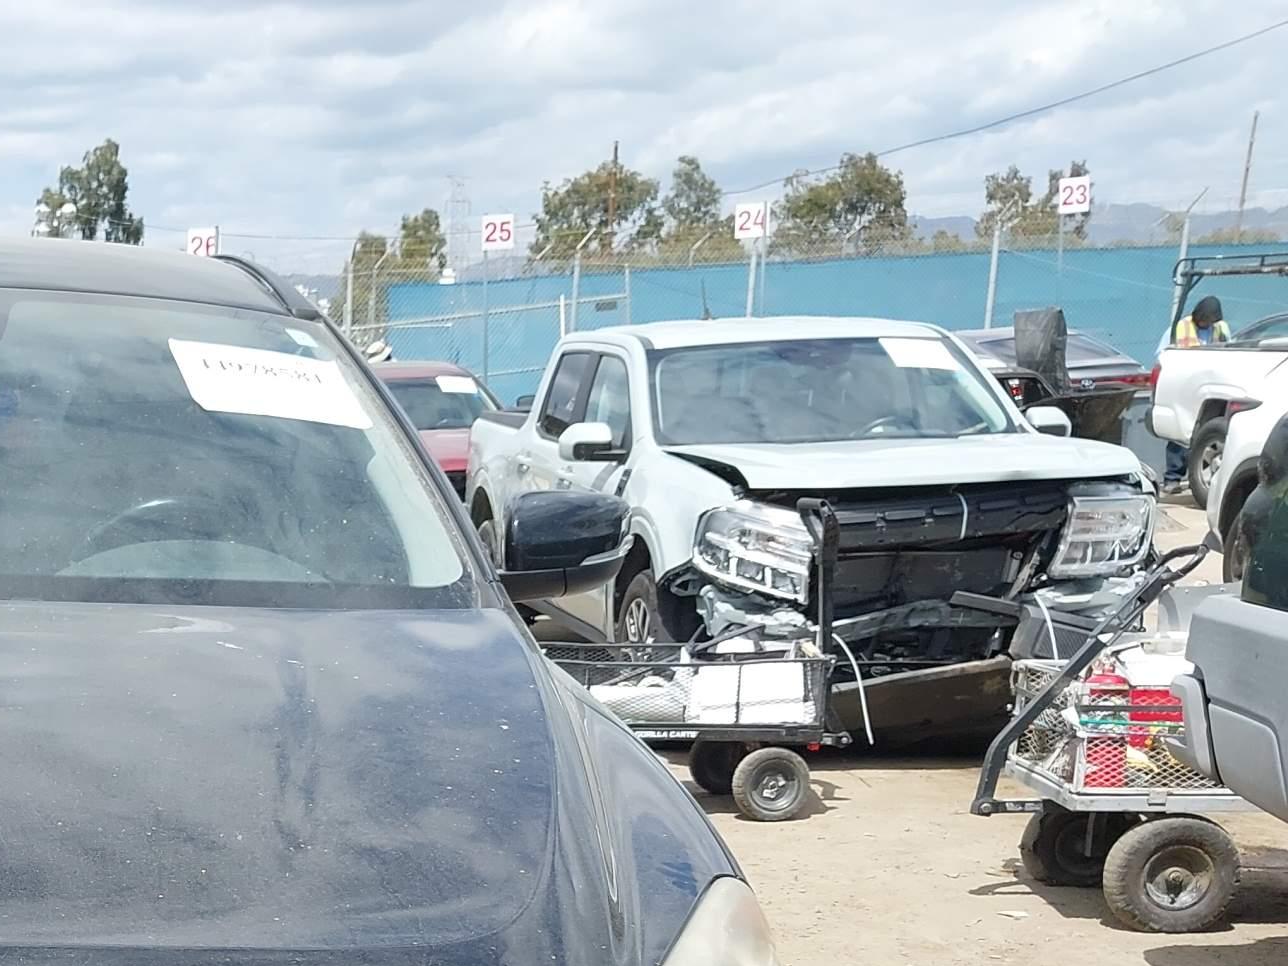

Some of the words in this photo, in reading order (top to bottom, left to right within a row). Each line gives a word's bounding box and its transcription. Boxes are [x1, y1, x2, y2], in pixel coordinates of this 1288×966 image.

[1063, 184, 1087, 206] 23
[485, 220, 511, 242] 25
[739, 209, 765, 231] 24
